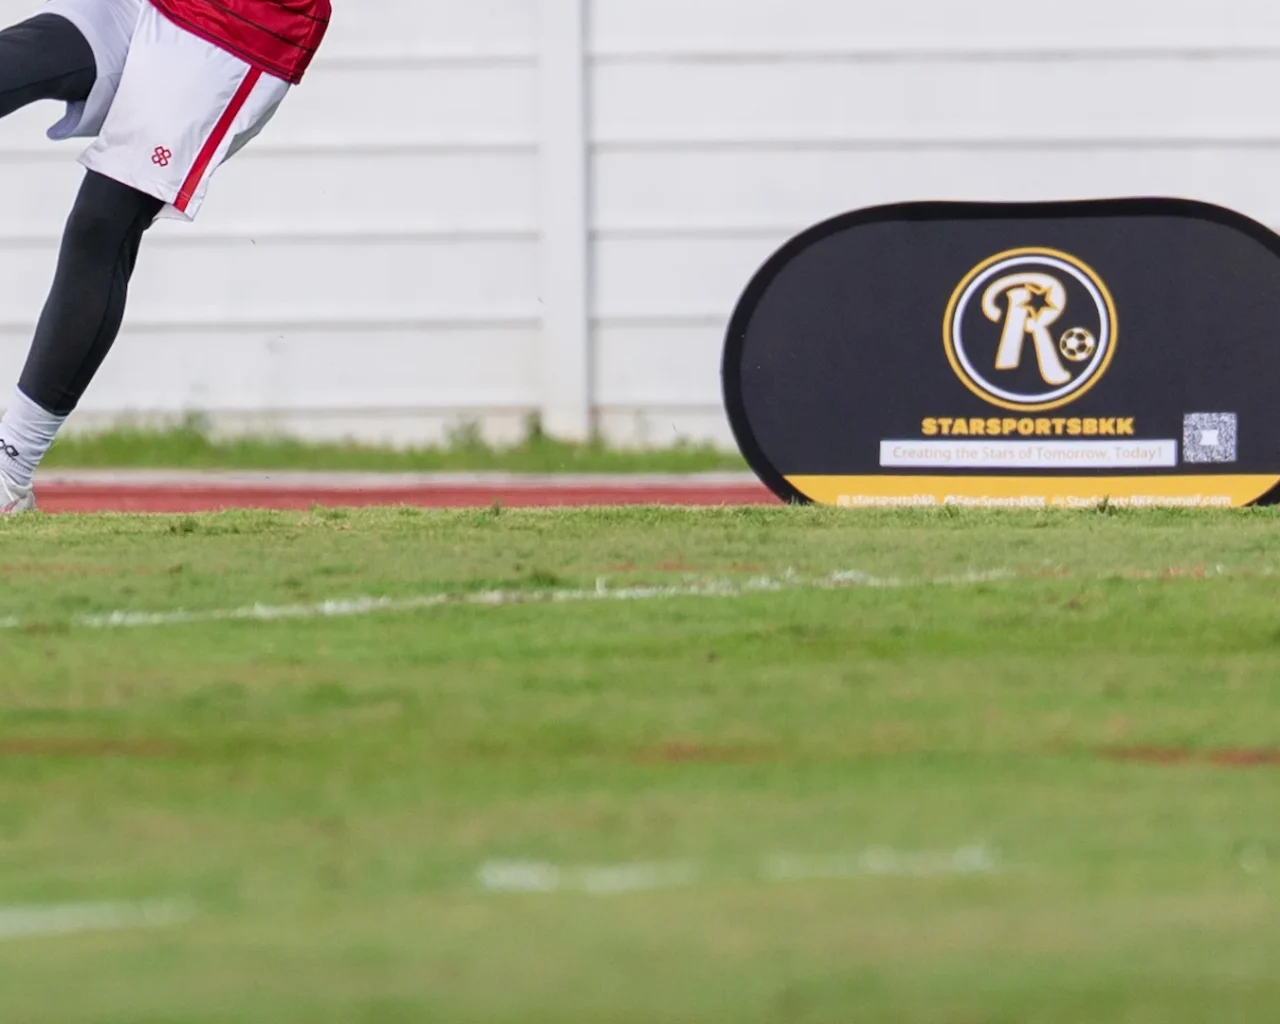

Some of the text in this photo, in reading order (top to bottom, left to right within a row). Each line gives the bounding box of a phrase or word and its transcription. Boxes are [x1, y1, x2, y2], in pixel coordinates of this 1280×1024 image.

[982, 272, 1071, 385] R
[921, 416, 1135, 436] STARSPORTSBKK
[892, 445, 1162, 461] Creating the Stars of Tomorrow, Today!
